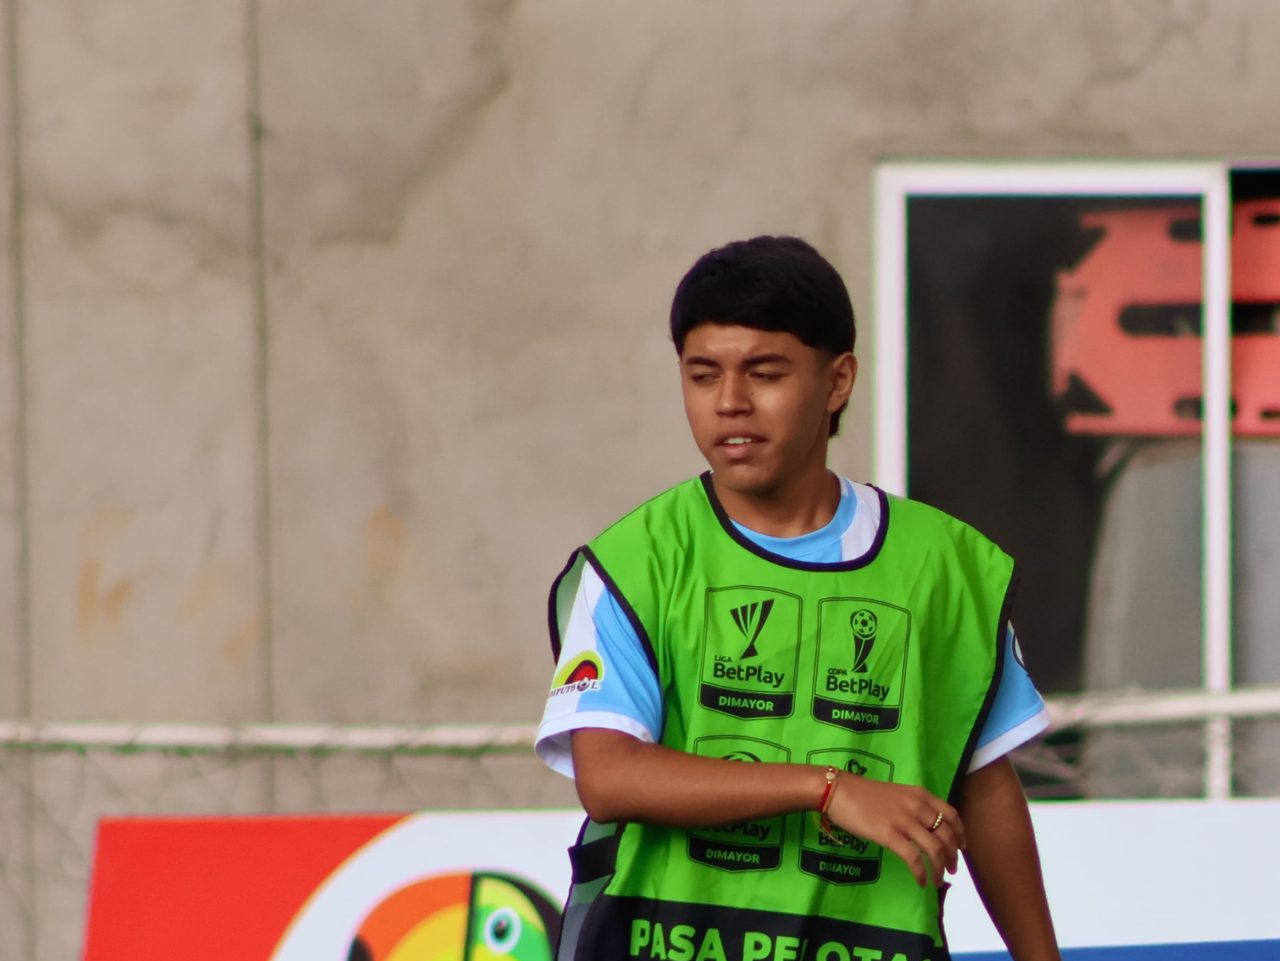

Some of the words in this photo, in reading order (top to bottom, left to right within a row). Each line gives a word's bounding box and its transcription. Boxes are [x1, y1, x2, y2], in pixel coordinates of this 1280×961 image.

[715, 655, 732, 663] LIGA
[713, 662, 785, 688] BetPlay
[826, 675, 890, 701] BetPlay
[719, 696, 774, 711] DIMAYOR
[832, 709, 880, 725] DIMAYOR
[706, 849, 760, 864] DIMAYOR
